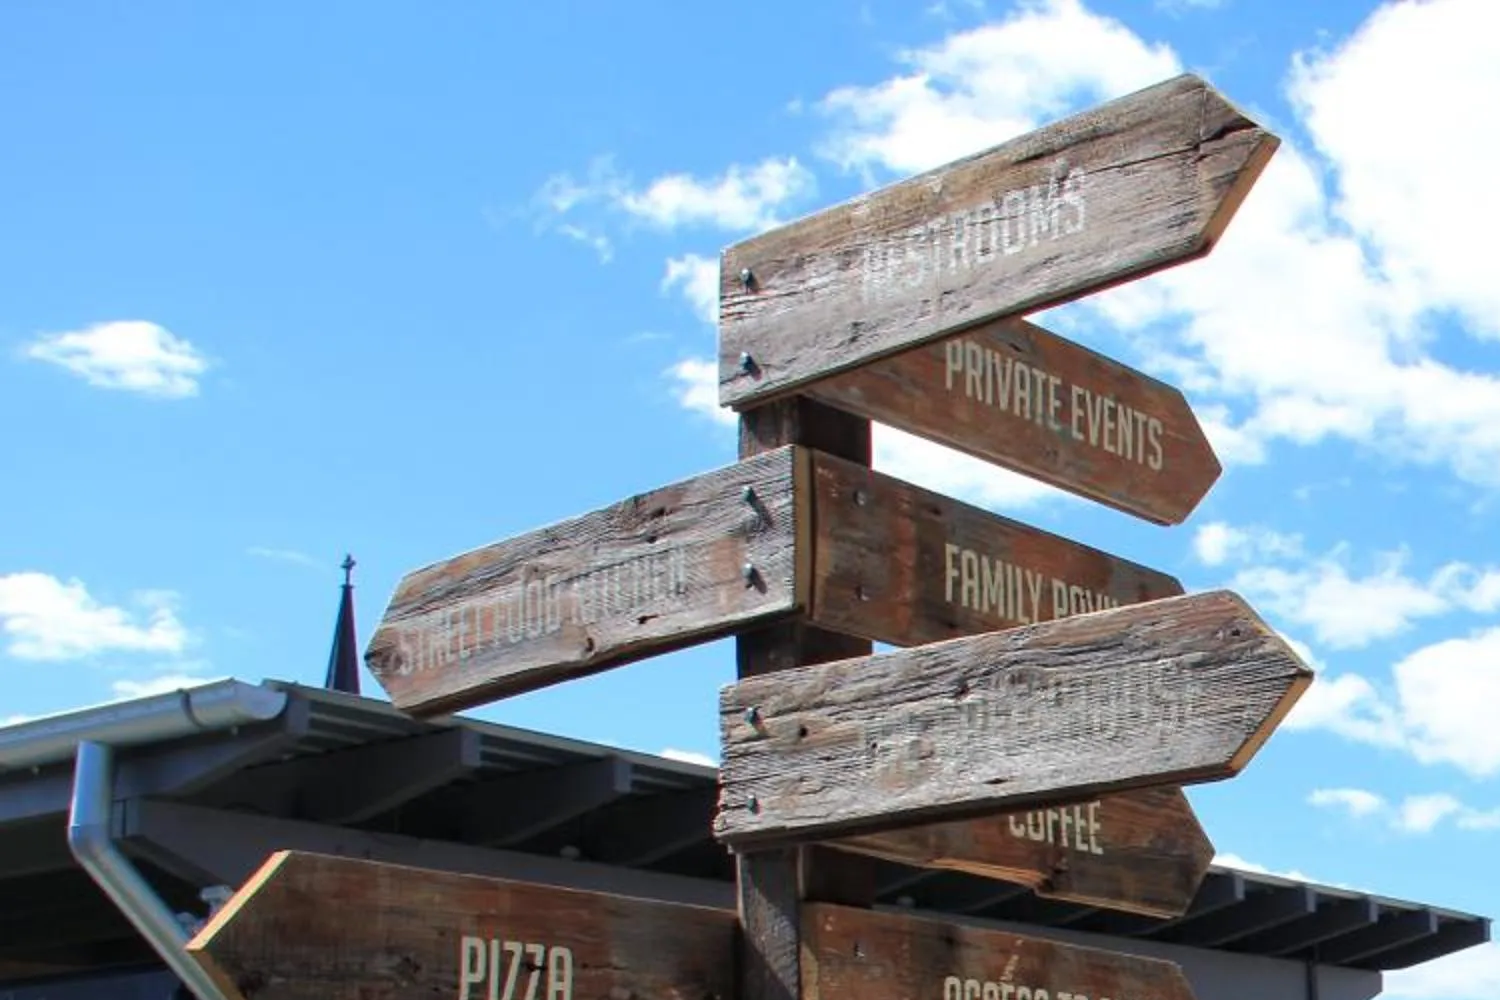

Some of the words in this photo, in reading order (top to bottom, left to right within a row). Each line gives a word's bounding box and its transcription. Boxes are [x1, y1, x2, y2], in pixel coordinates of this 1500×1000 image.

[945, 339, 1062, 431] PRIVATE
[1070, 383, 1163, 471] EVENTS
[945, 543, 1042, 625] FAMILY
